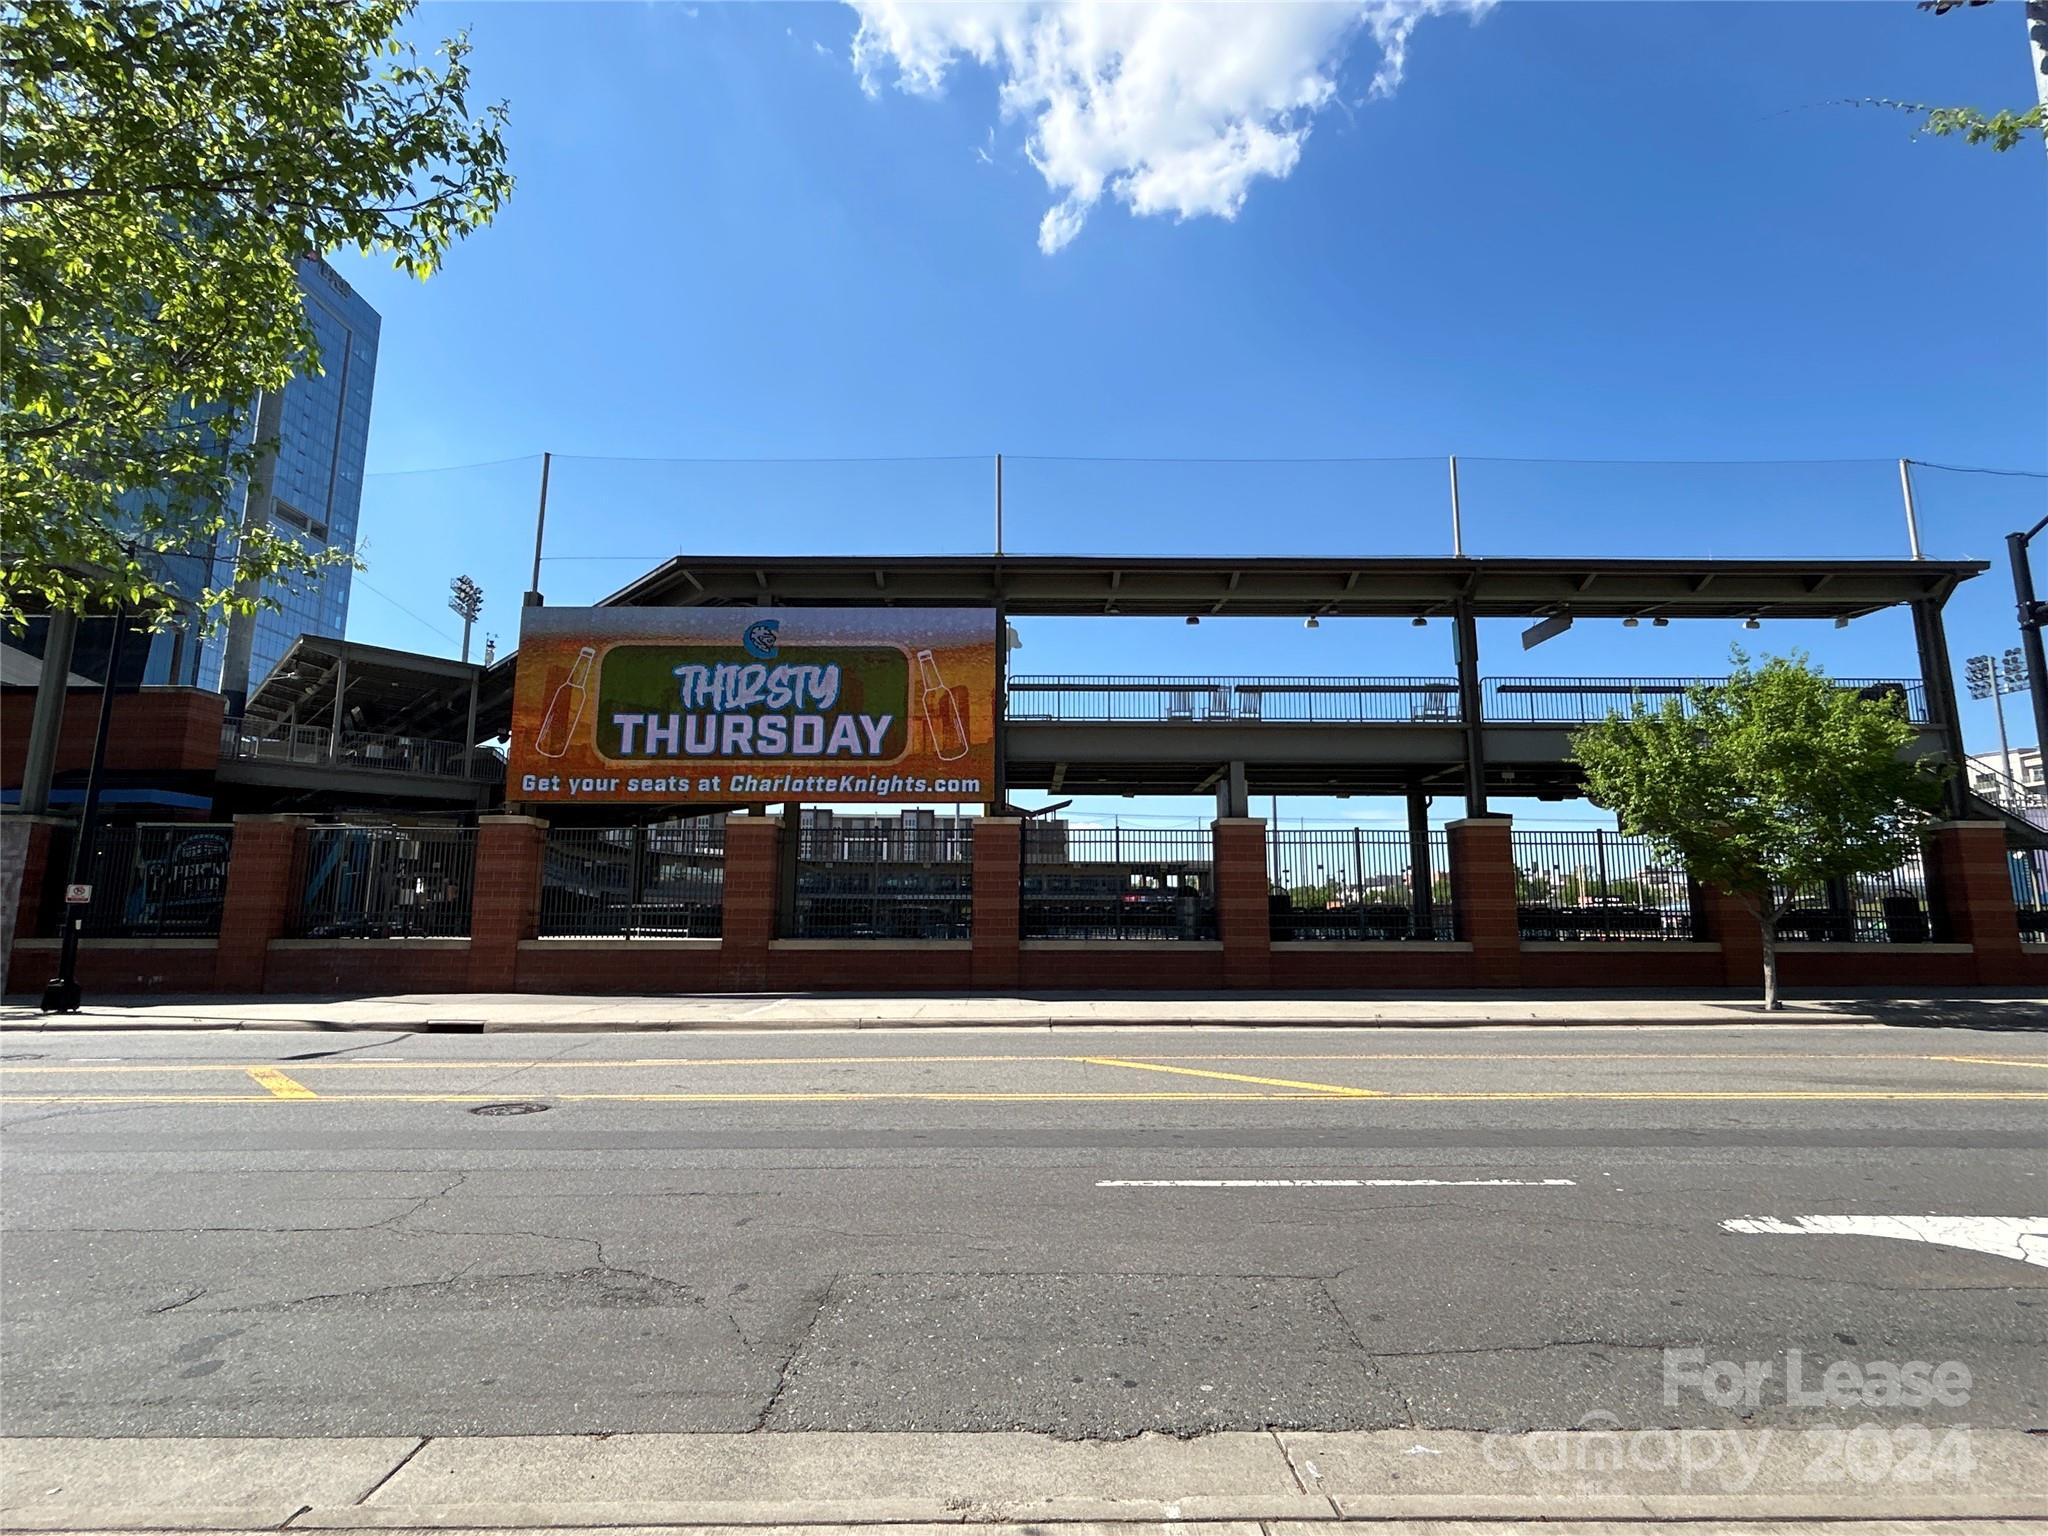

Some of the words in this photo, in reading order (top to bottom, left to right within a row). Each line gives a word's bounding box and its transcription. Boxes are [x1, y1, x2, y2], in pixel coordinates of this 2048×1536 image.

[674, 664, 839, 710] THIRSTY
[613, 714, 892, 755] THURSDAY
[522, 774, 560, 792] Get
[569, 777, 619, 795] your
[627, 775, 689, 792] seats
[698, 775, 721, 792] at
[729, 774, 980, 796] CharlotteKnights.com
